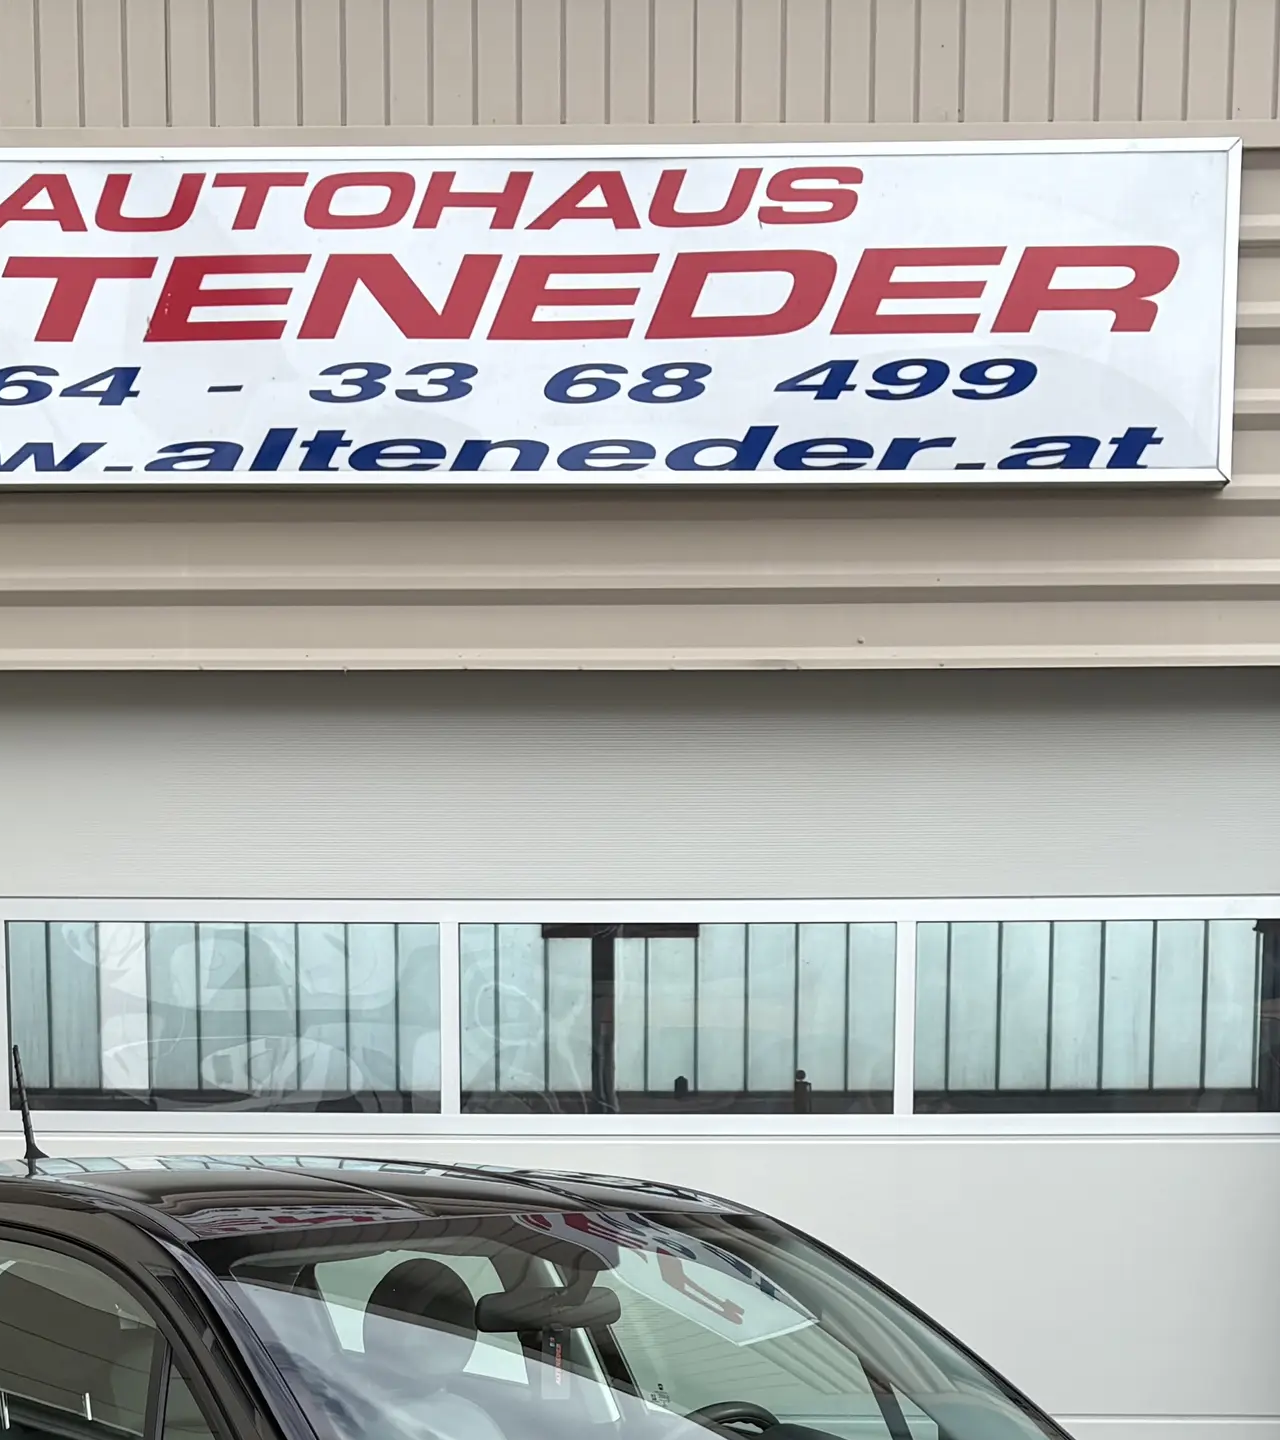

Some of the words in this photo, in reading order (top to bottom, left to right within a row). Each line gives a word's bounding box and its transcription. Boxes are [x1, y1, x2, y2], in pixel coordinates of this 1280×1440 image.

[308, 363, 478, 404] 33
[542, 362, 714, 404] 68
[774, 358, 1040, 402] 499
